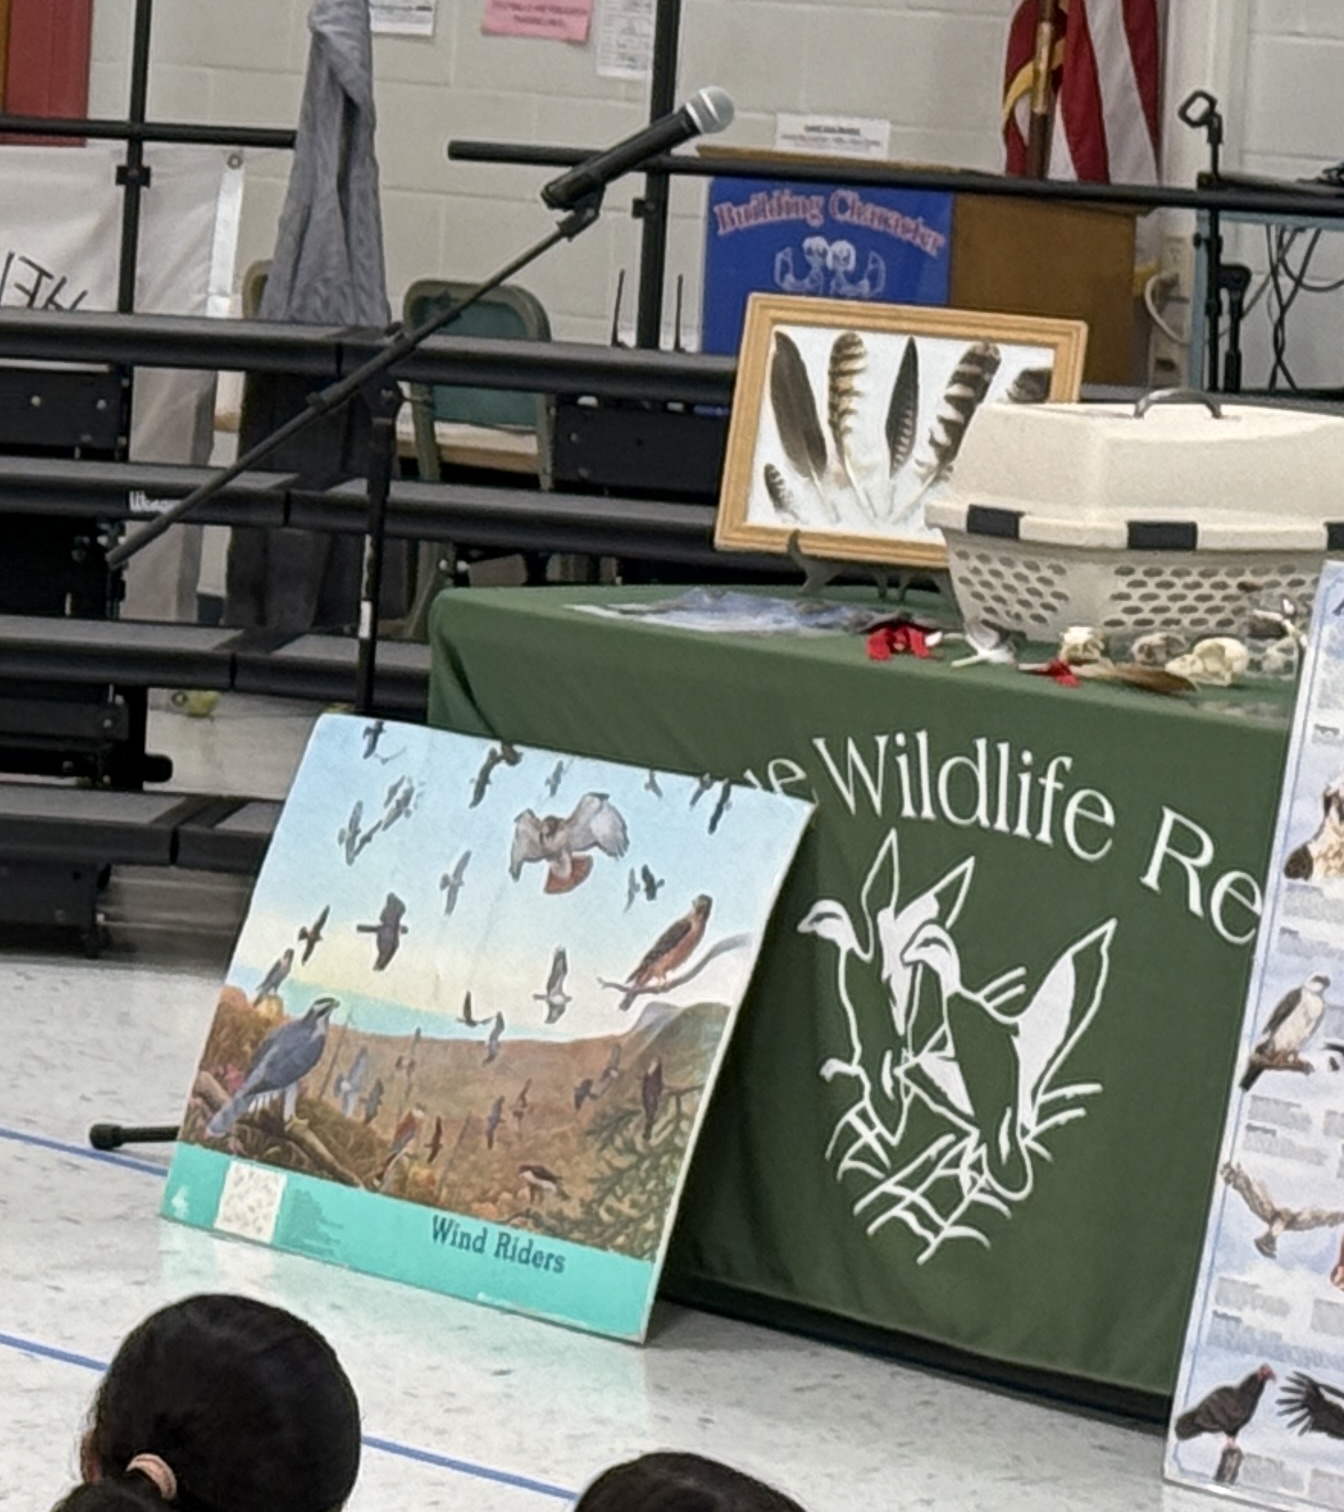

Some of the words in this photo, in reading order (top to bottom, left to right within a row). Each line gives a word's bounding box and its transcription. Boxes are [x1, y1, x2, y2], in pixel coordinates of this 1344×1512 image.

[714, 188, 826, 236] Building
[829, 188, 946, 258] Character
[813, 729, 1115, 861] Wildlife
[432, 1214, 488, 1255] Wind
[494, 1232, 566, 1274] Riders
